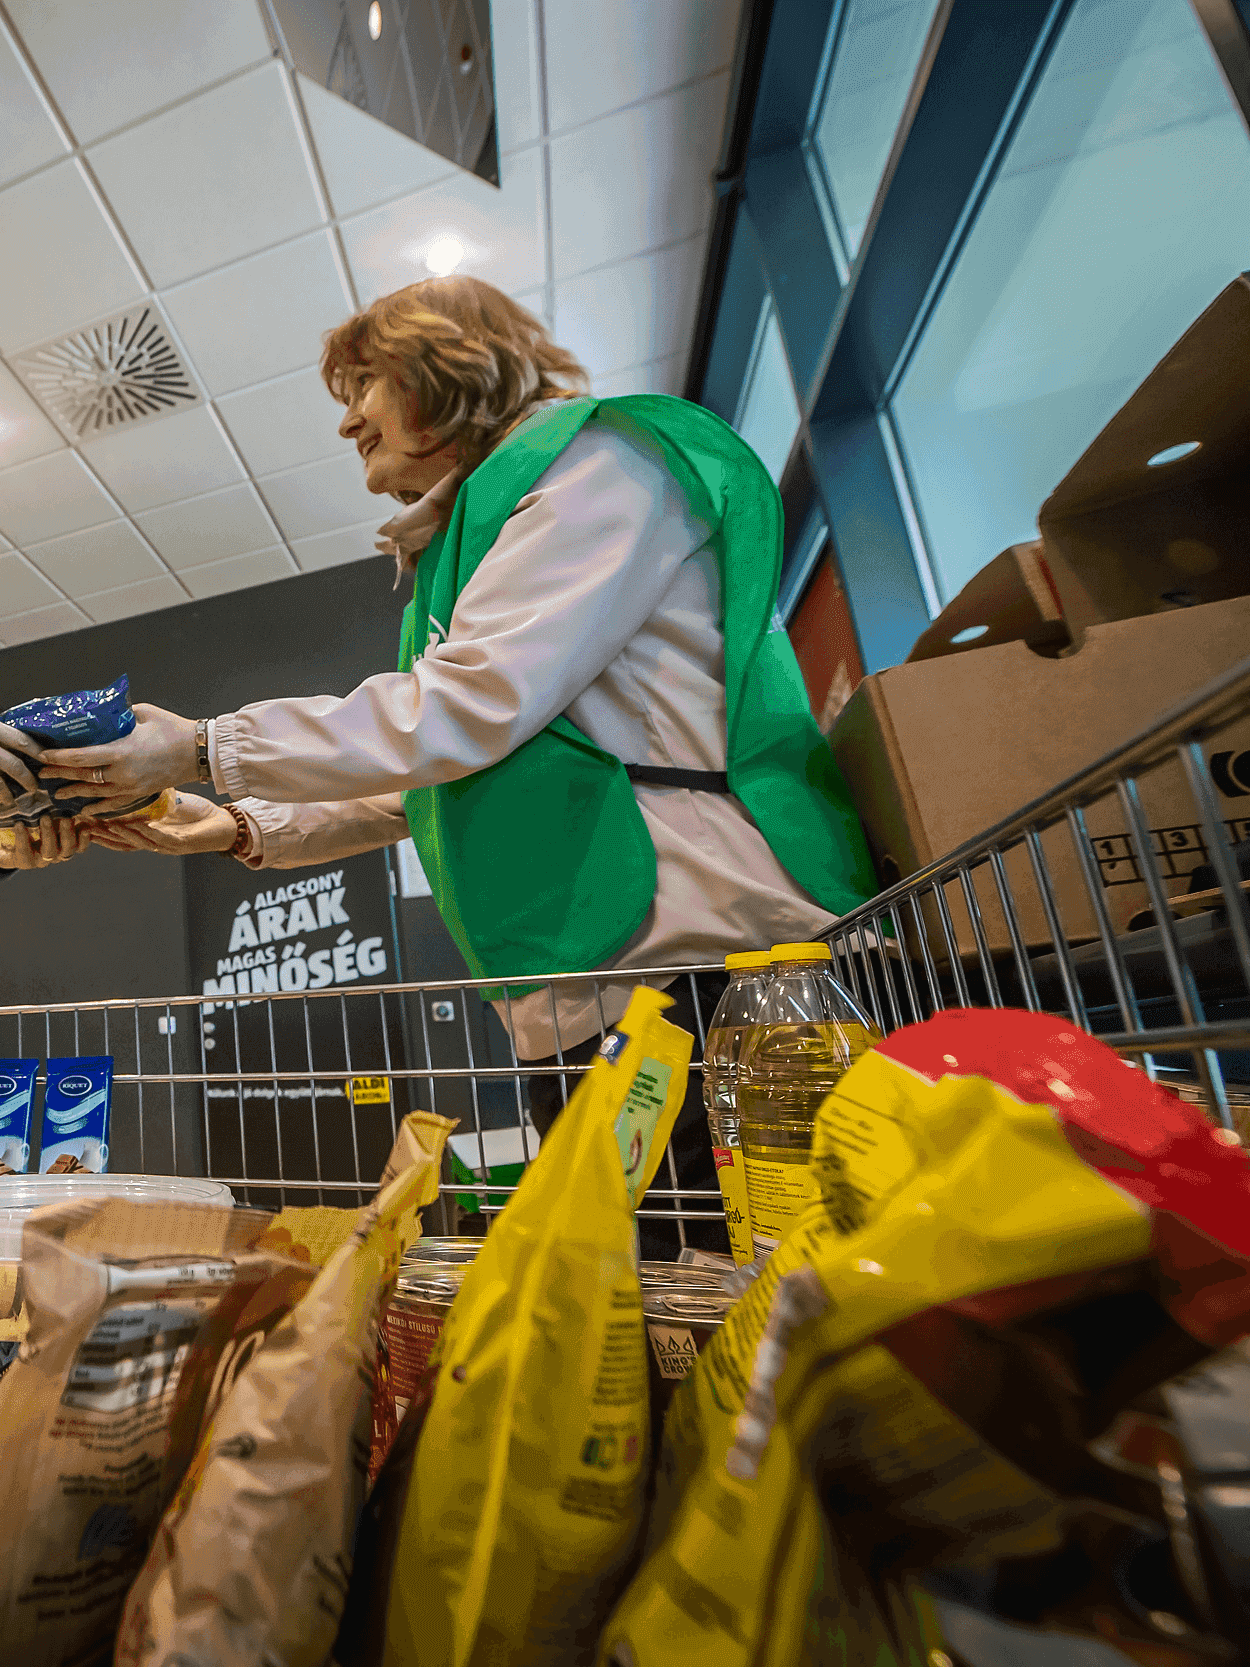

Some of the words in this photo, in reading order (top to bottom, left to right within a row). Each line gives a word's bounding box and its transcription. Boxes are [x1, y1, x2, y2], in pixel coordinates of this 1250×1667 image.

[1101, 841, 1114, 856] 1
[1170, 832, 1188, 847] 3
[254, 870, 344, 911] ALACSONY
[228, 887, 350, 952] ÁRAK
[202, 929, 387, 1015] MINŐSÉG
[217, 946, 277, 976] MAGAS
